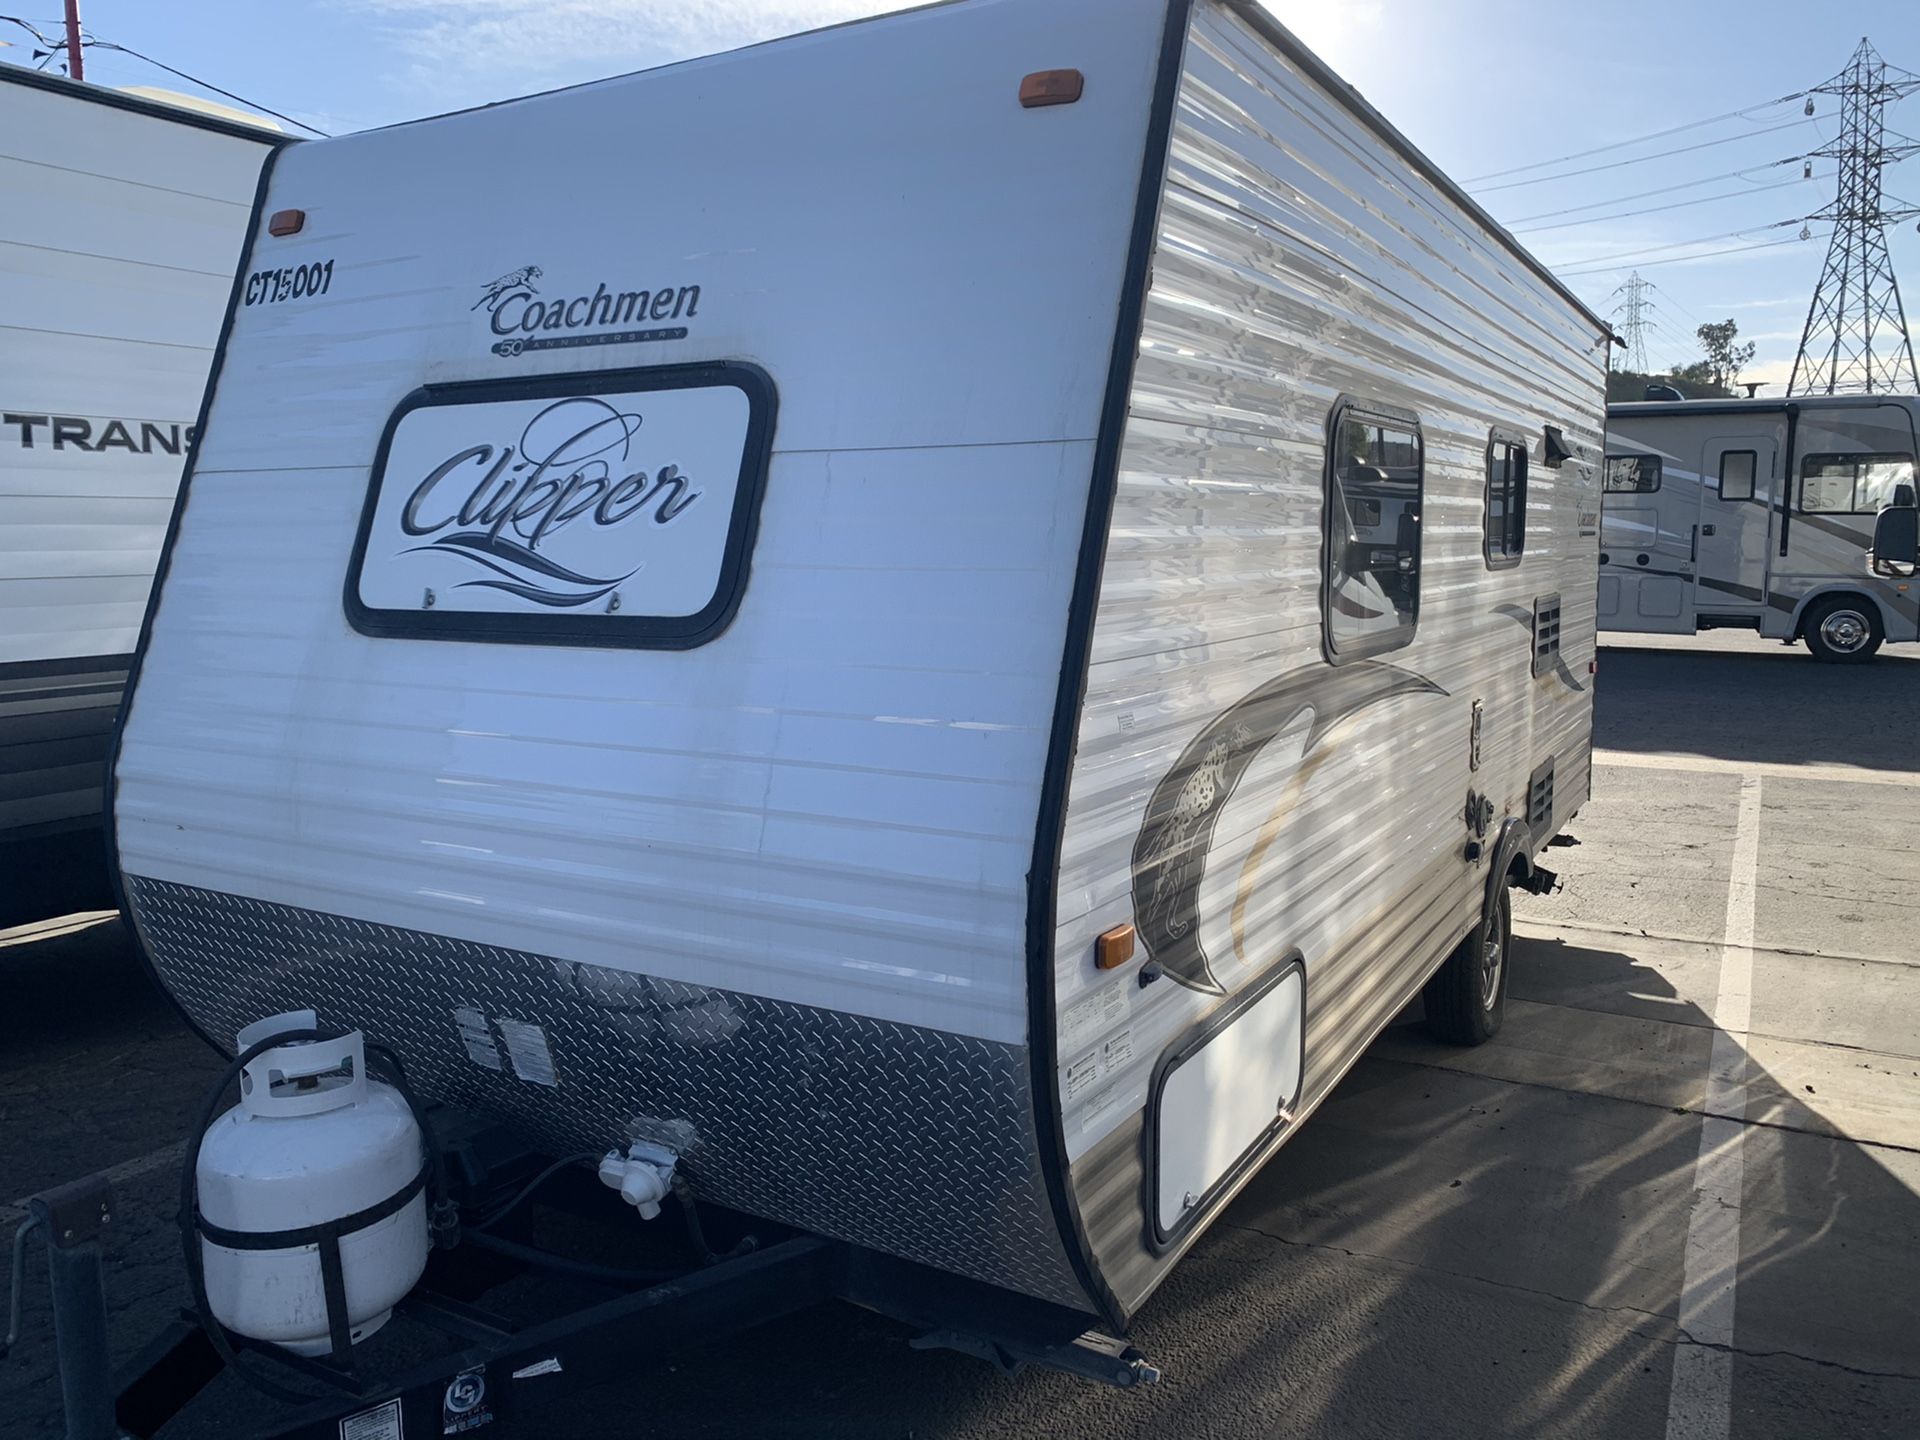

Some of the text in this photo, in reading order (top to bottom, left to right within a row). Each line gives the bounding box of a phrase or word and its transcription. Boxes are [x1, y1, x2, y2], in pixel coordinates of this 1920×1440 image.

[245, 259, 335, 307] CT15001
[491, 283, 700, 336] Coachmen
[533, 330, 683, 349] ANNIVERSARY
[400, 397, 702, 550] Clipper
